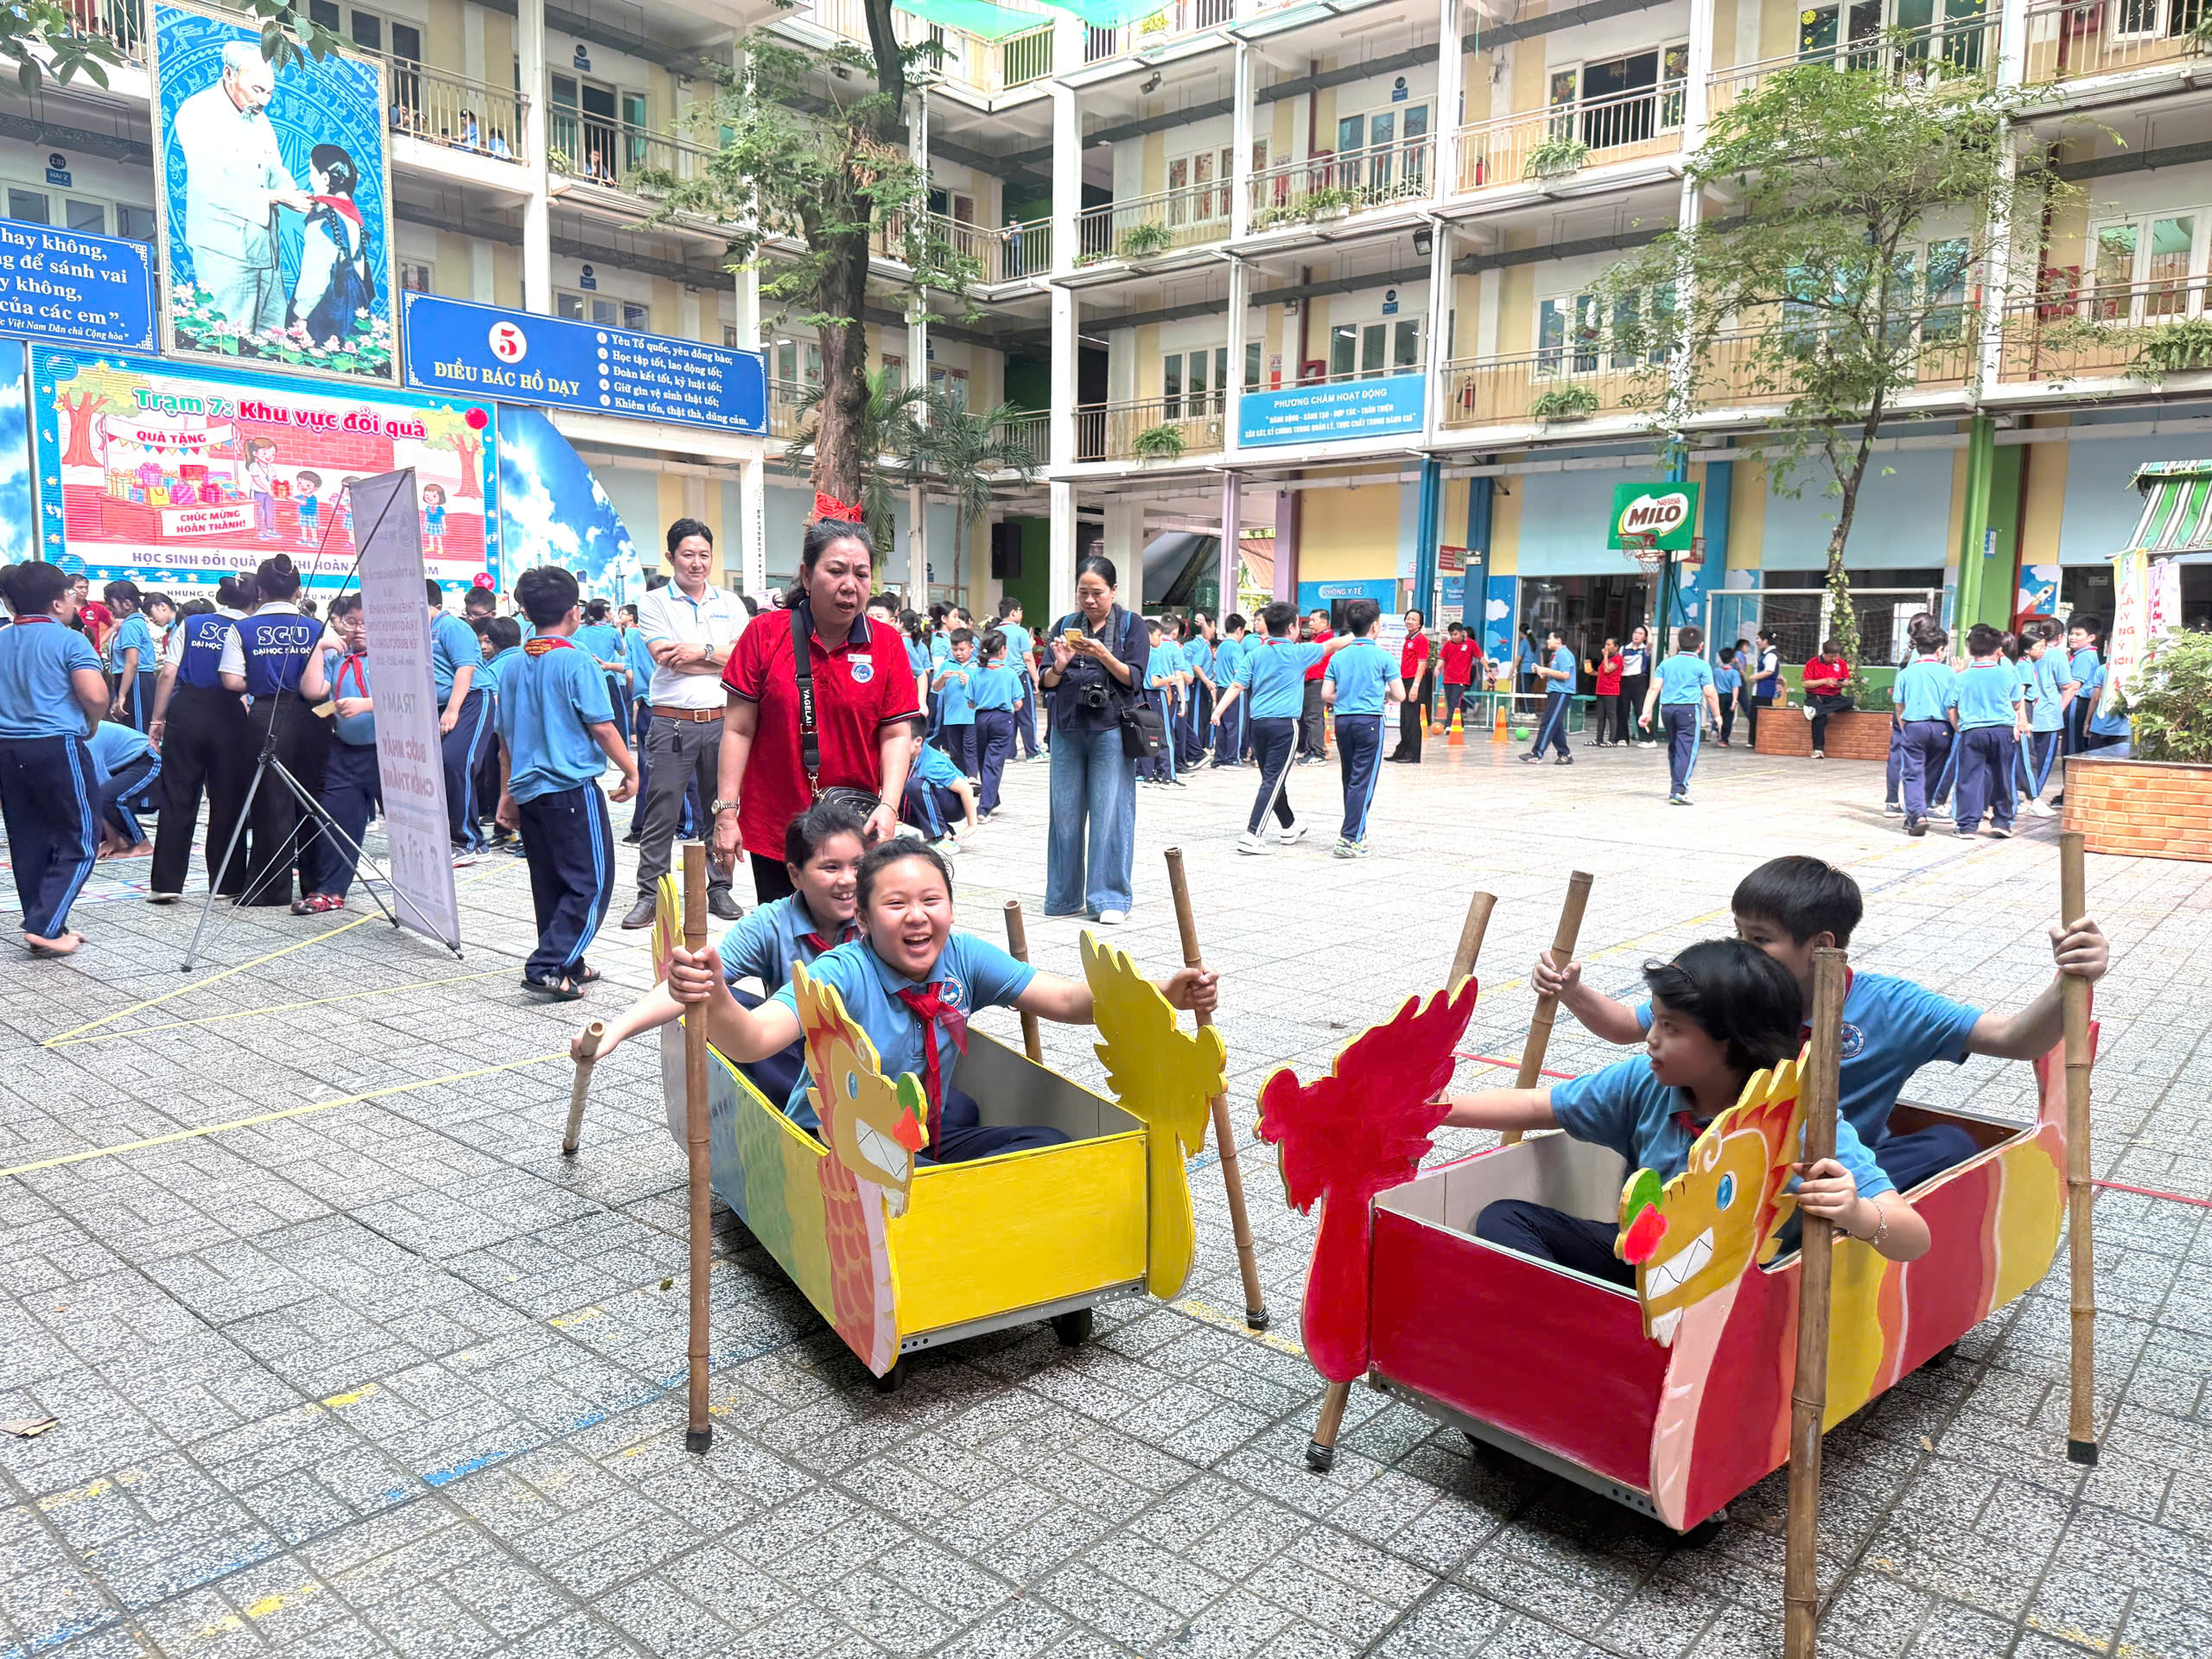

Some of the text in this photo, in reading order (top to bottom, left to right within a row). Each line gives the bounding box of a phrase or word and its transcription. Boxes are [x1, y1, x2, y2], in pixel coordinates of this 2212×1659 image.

[1, 227, 108, 262] hay không,
[20, 253, 44, 270] để
[50, 260, 95, 279] sánh
[100, 270, 128, 283] vai
[16, 276, 82, 302] không,
[0, 296, 34, 315] của
[40, 304, 73, 321] các
[8, 318, 25, 328] Việt
[27, 321, 47, 331] Nam
[48, 324, 67, 334] Dân
[68, 326, 84, 335] chủ
[86, 328, 106, 340] Cộng
[499, 328, 518, 356] 5
[611, 334, 631, 346] Yêu
[632, 337, 645, 349] Tổ
[647, 341, 671, 355] quốc,
[673, 346, 690, 357] yêu
[691, 348, 713, 362] đồng
[715, 353, 733, 365] bào;
[613, 350, 632, 363] Học
[633, 354, 648, 367] tập
[651, 357, 666, 370] tốt,
[669, 360, 682, 371] lao
[684, 364, 706, 377] động
[708, 366, 722, 378] tốt;
[434, 358, 580, 397] ĐIỀU BÁC HỒ DẠY
[613, 366, 638, 380] Đoàn
[639, 369, 655, 382] kết
[658, 372, 672, 385] tốt,
[688, 378, 705, 391] luật
[708, 382, 722, 394] tốt;
[614, 382, 632, 394] Giữ
[633, 385, 648, 397] gìn
[650, 388, 661, 399] vệ
[664, 390, 682, 402] sinh
[684, 393, 702, 405] thật
[704, 396, 720, 408] tốt;
[1362, 388, 1388, 399] ĐỘNG
[135, 388, 427, 440] Trạm 7: Khu vực đổi quà
[614, 397, 645, 411] Khiêm
[647, 402, 665, 416] tốn,
[667, 405, 685, 418] thật
[687, 408, 705, 421] thà,
[706, 411, 728, 424] dũng
[729, 414, 749, 426] cảm.
[137, 430, 207, 445] QUÀ TẶNG
[176, 519, 246, 533] HOÀN THÀNH!
[180, 509, 240, 522] CHÚC MỪNG
[1628, 505, 1681, 526] MILO
[132, 552, 162, 566] HỌC
[165, 554, 199, 565] SINH
[201, 550, 226, 566] ĐỔI
[230, 555, 257, 568] QUÀ
[315, 558, 349, 571] HOÀN
[191, 640, 222, 651] ĐẠI HỌC
[200, 622, 229, 644] SG
[257, 626, 309, 645] SGU
[253, 647, 266, 657] ĐẠI
[266, 646, 283, 655] HỌC
[300, 645, 311, 654] GÒ
[803, 689, 812, 726] YAGELAI
